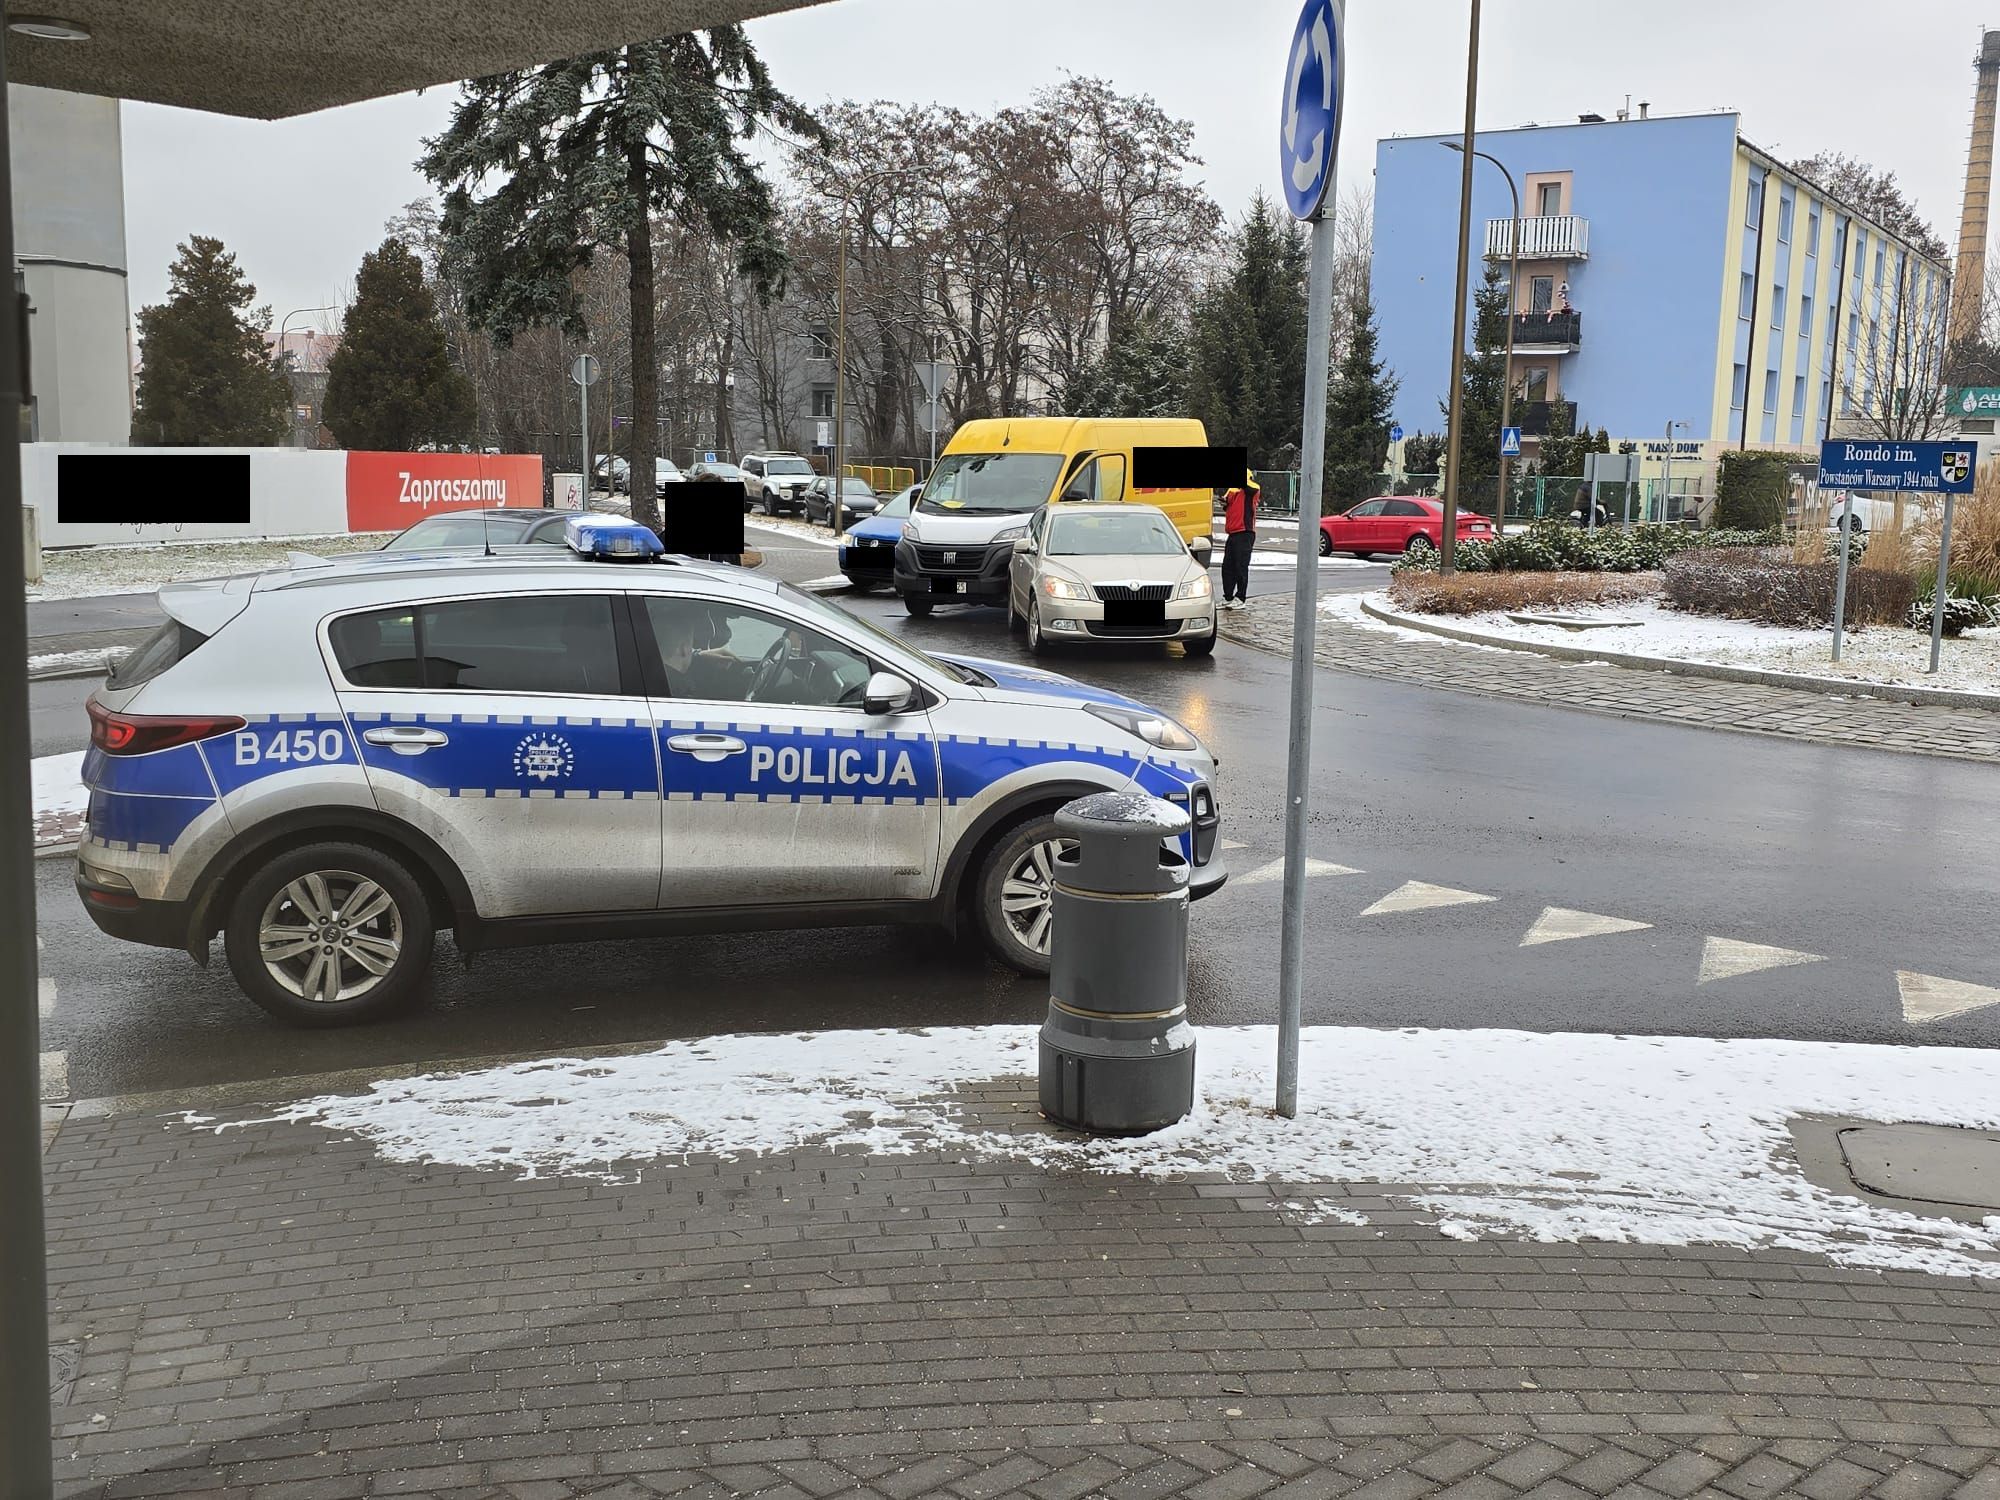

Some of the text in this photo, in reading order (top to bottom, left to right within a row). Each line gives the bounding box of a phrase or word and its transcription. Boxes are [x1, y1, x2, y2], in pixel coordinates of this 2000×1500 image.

[1977, 401, 2000, 409] CE
[1844, 444, 1917, 462] Rondo im.
[1820, 468, 1864, 486] Powstańców
[1865, 469, 1902, 489] Warszawy
[1902, 471, 1920, 487] 1944
[1920, 470, 1939, 488] roku
[399, 472, 506, 509] Zapraszamy
[943, 552, 957, 565] FIAT
[750, 745, 918, 786] POLICJA
